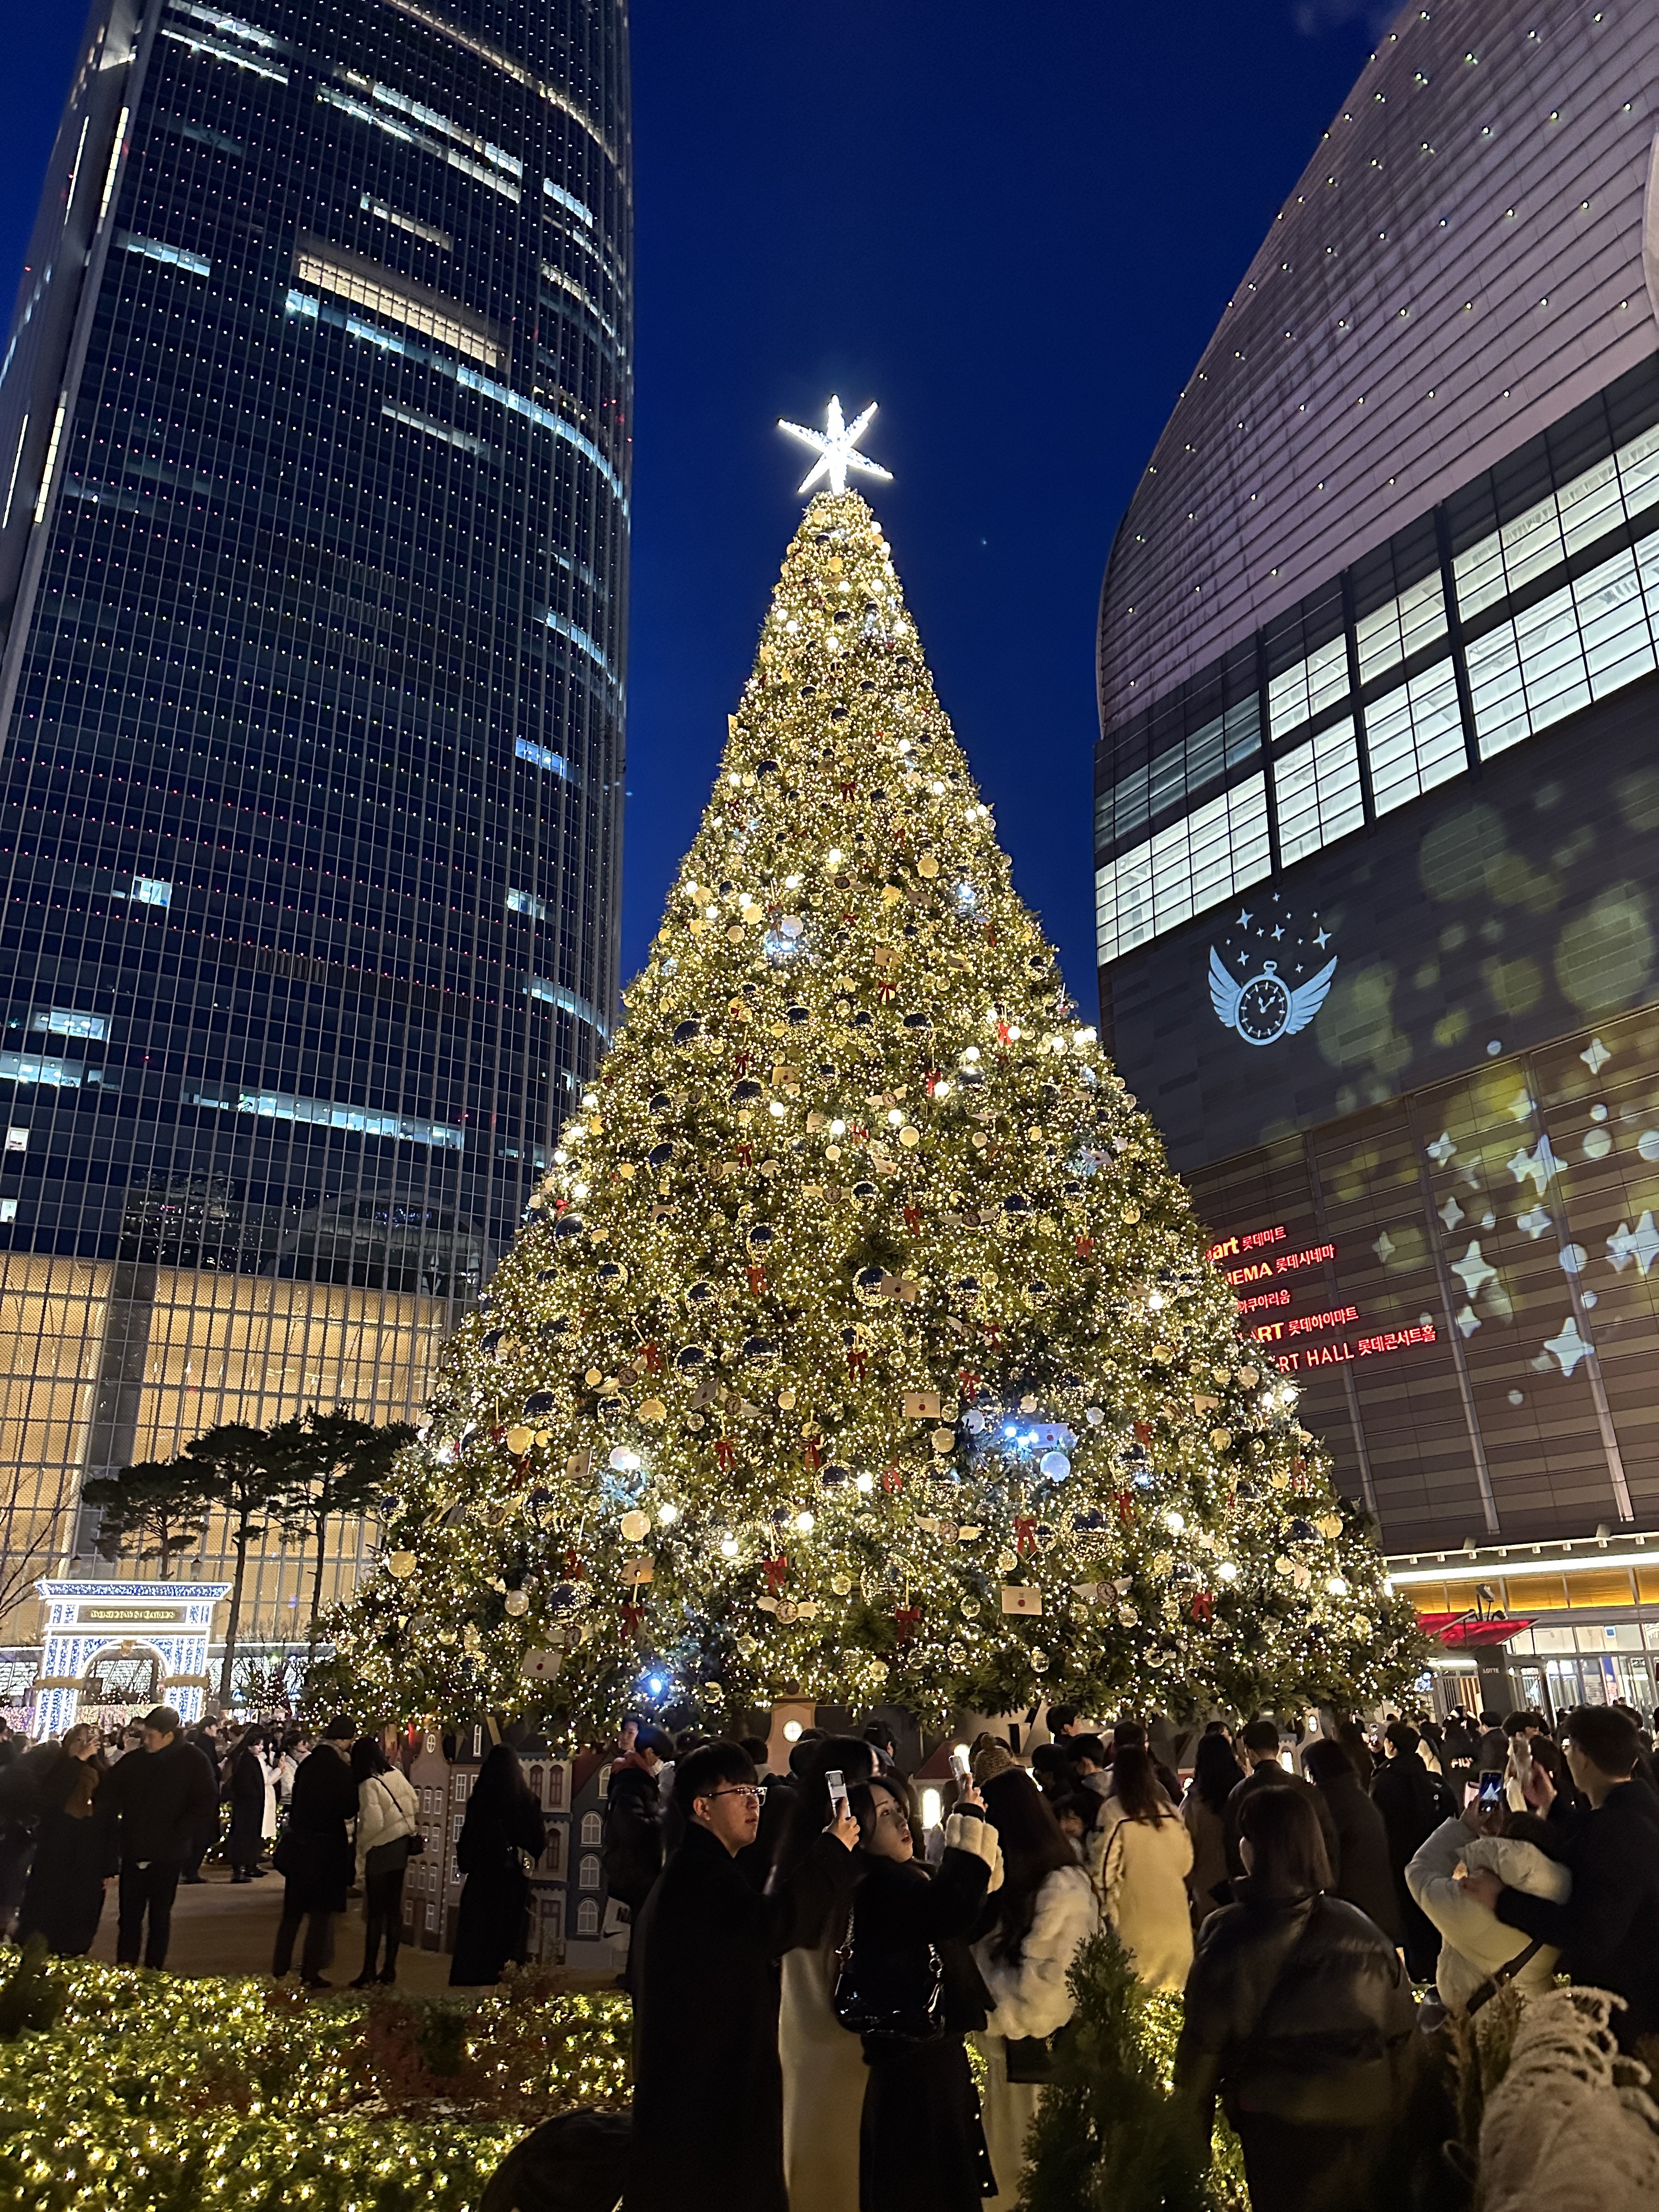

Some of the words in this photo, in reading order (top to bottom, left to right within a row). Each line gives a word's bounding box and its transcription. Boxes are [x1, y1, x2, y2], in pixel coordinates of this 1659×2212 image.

[1276, 1244, 1335, 1274] 롯데시네마
[1288, 1306, 1359, 1336] 롯데하이마트
[1306, 1342, 1355, 1367] HALL
[1358, 1324, 1436, 1356] 롯데콘서트홀
